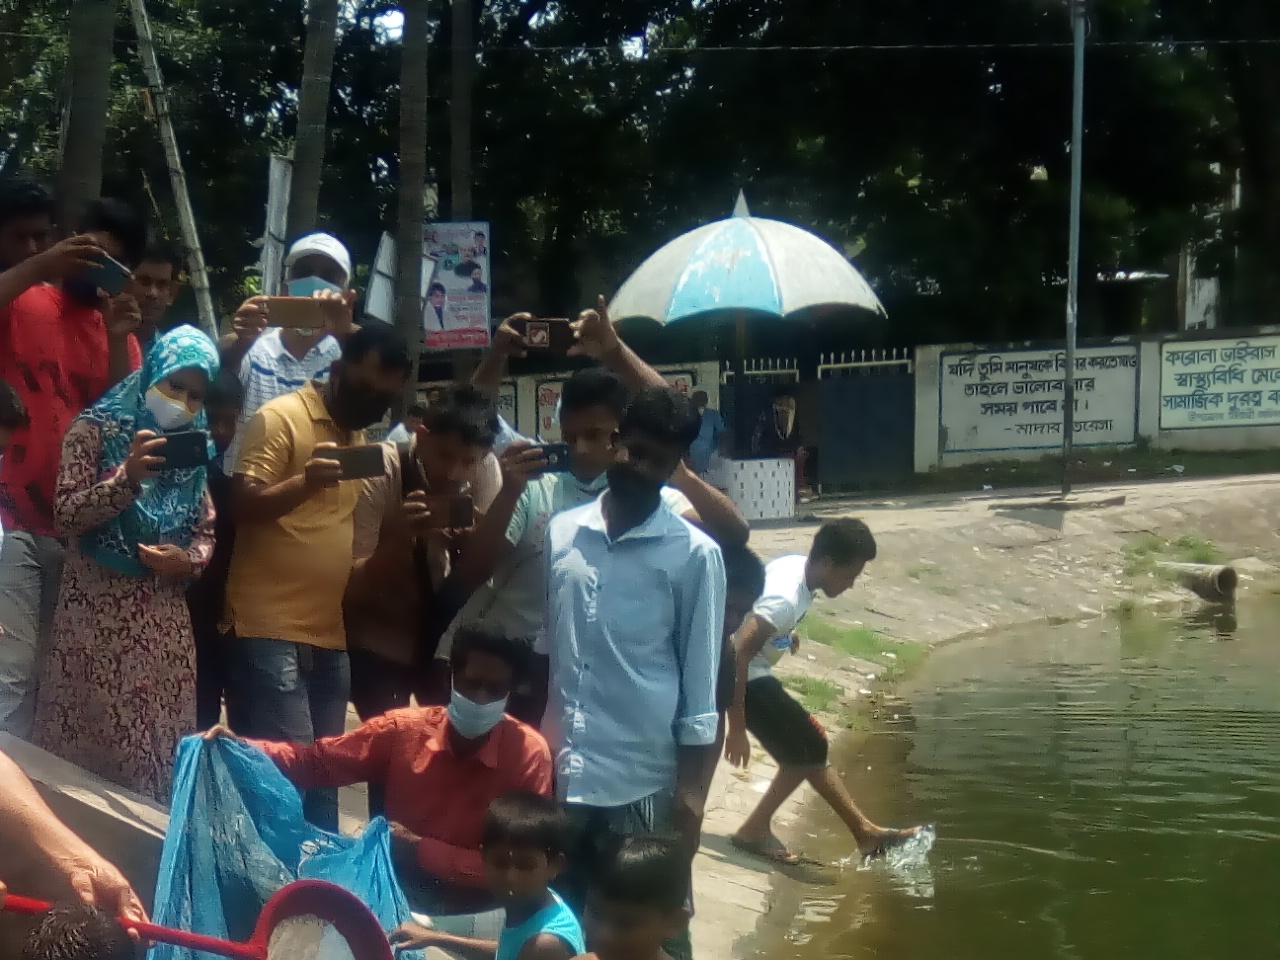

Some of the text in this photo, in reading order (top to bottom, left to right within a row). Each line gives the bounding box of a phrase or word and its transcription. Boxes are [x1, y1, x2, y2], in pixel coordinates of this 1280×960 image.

[1165, 341, 1278, 366] করোনা ভাইরাস
[948, 358, 975, 377] যদি
[978, 356, 1003, 381] তুমি
[1005, 360, 1054, 380] মানুষকে
[964, 382, 1009, 398] তাহলে
[1161, 390, 1224, 410] সামাজিক
